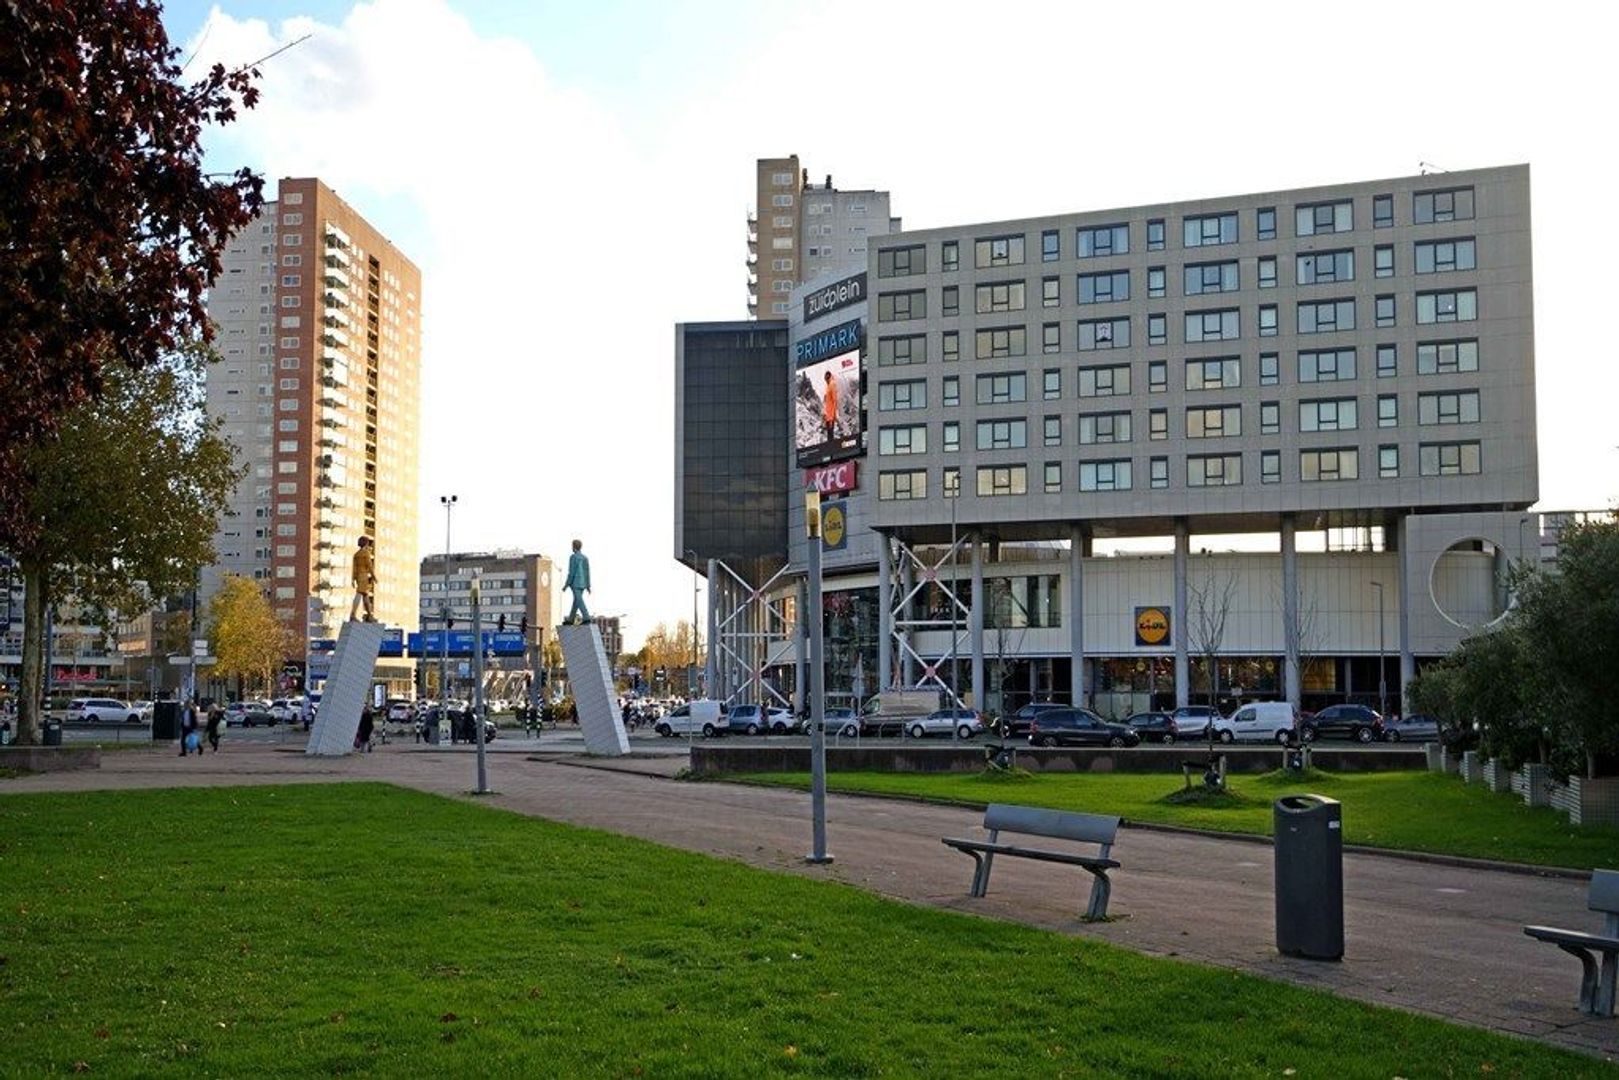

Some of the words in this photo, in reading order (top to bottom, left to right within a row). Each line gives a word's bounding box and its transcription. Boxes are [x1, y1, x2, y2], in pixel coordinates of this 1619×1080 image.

[808, 279, 861, 314] zuidplein
[796, 324, 858, 360] PRIMARK
[814, 464, 848, 491] KFC
